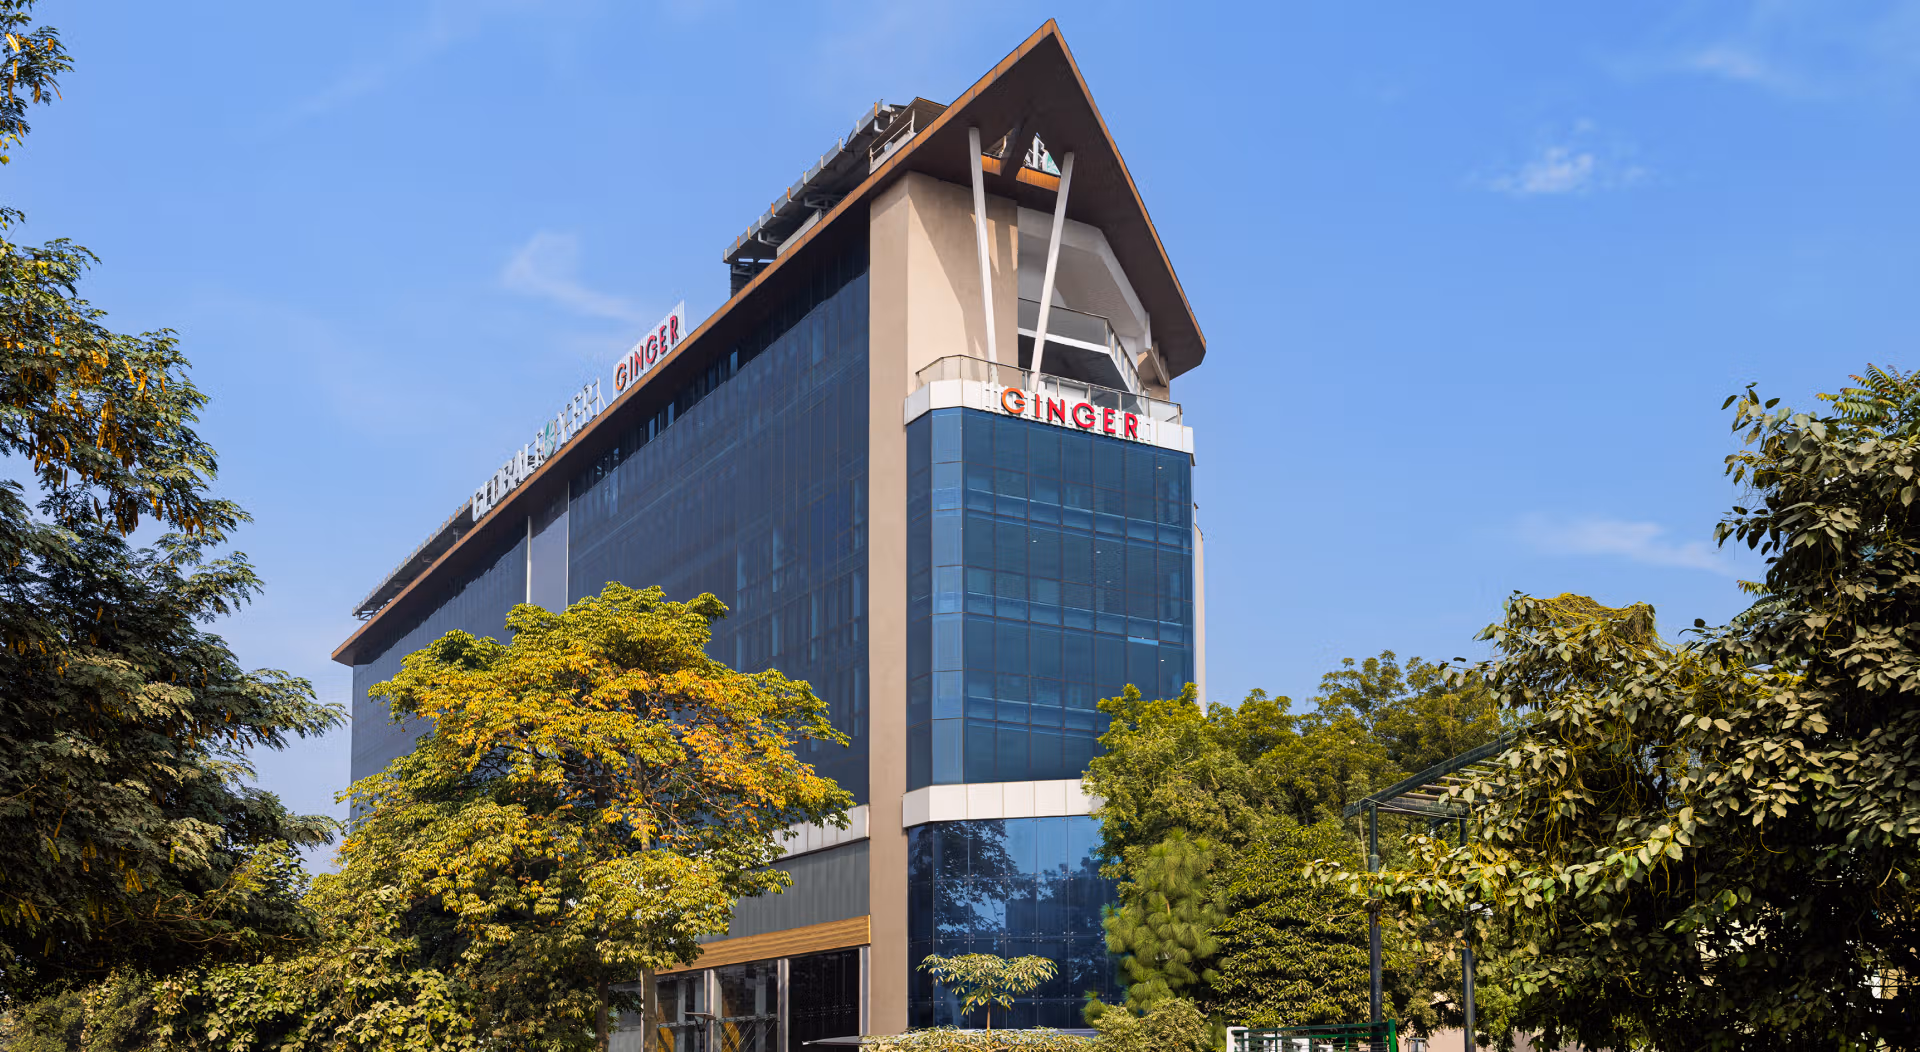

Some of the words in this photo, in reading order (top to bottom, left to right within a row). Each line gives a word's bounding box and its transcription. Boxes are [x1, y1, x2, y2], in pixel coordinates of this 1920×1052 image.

[616, 315, 679, 391] GINGER
[1001, 387, 1139, 439] GINGER
[472, 443, 535, 522] GLOBAL
